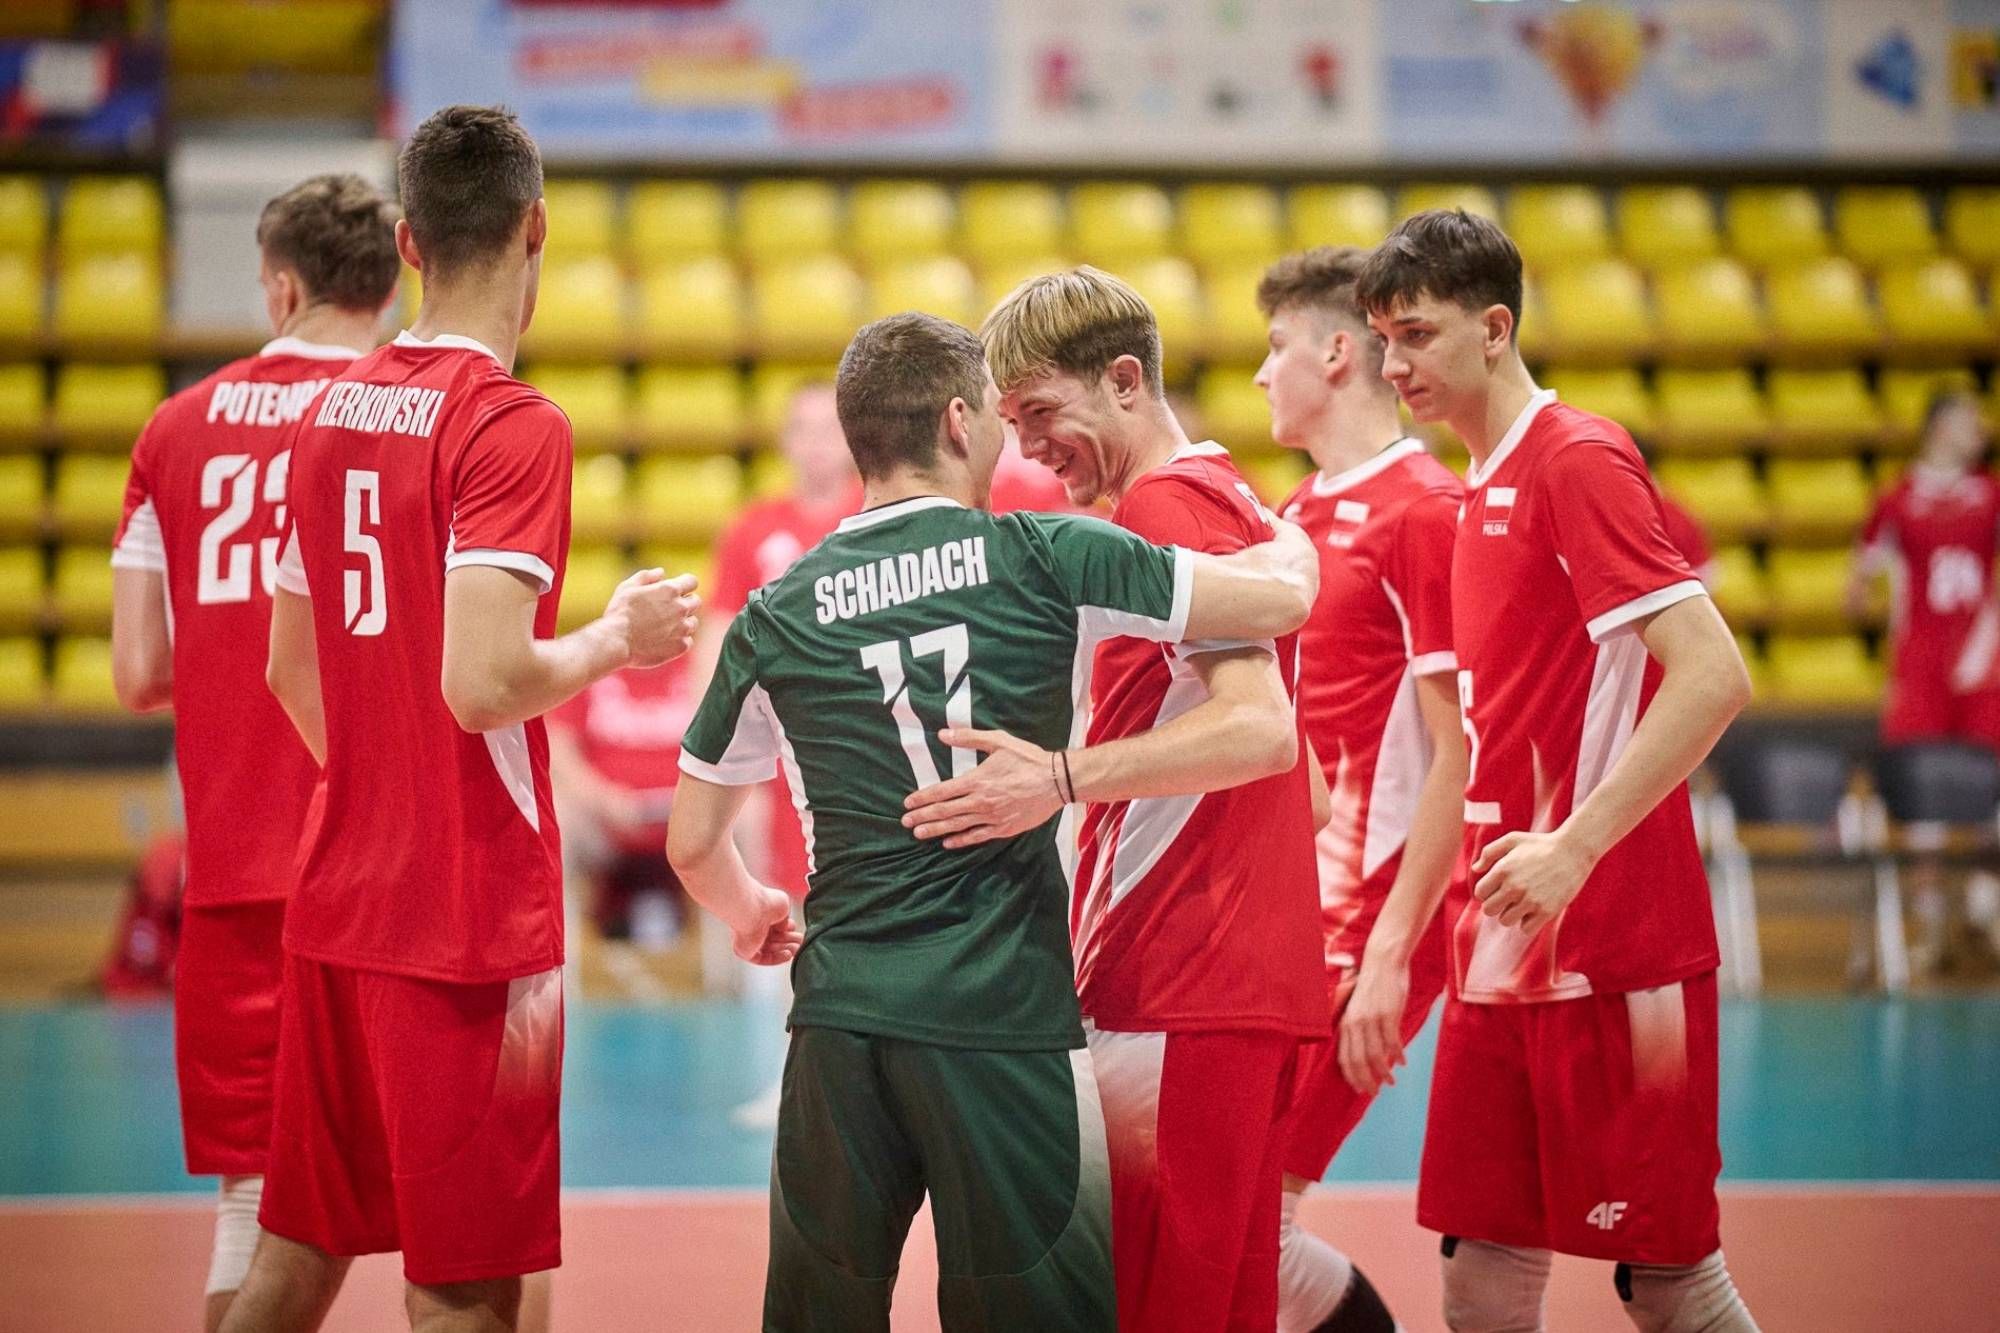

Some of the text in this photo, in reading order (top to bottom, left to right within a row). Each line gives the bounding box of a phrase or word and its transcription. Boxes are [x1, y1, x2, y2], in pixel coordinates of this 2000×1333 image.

[344, 469, 388, 636] 5
[814, 536, 990, 625] SCHADACH
[859, 622, 978, 792] 17
[1585, 1201, 1629, 1230] 4F
